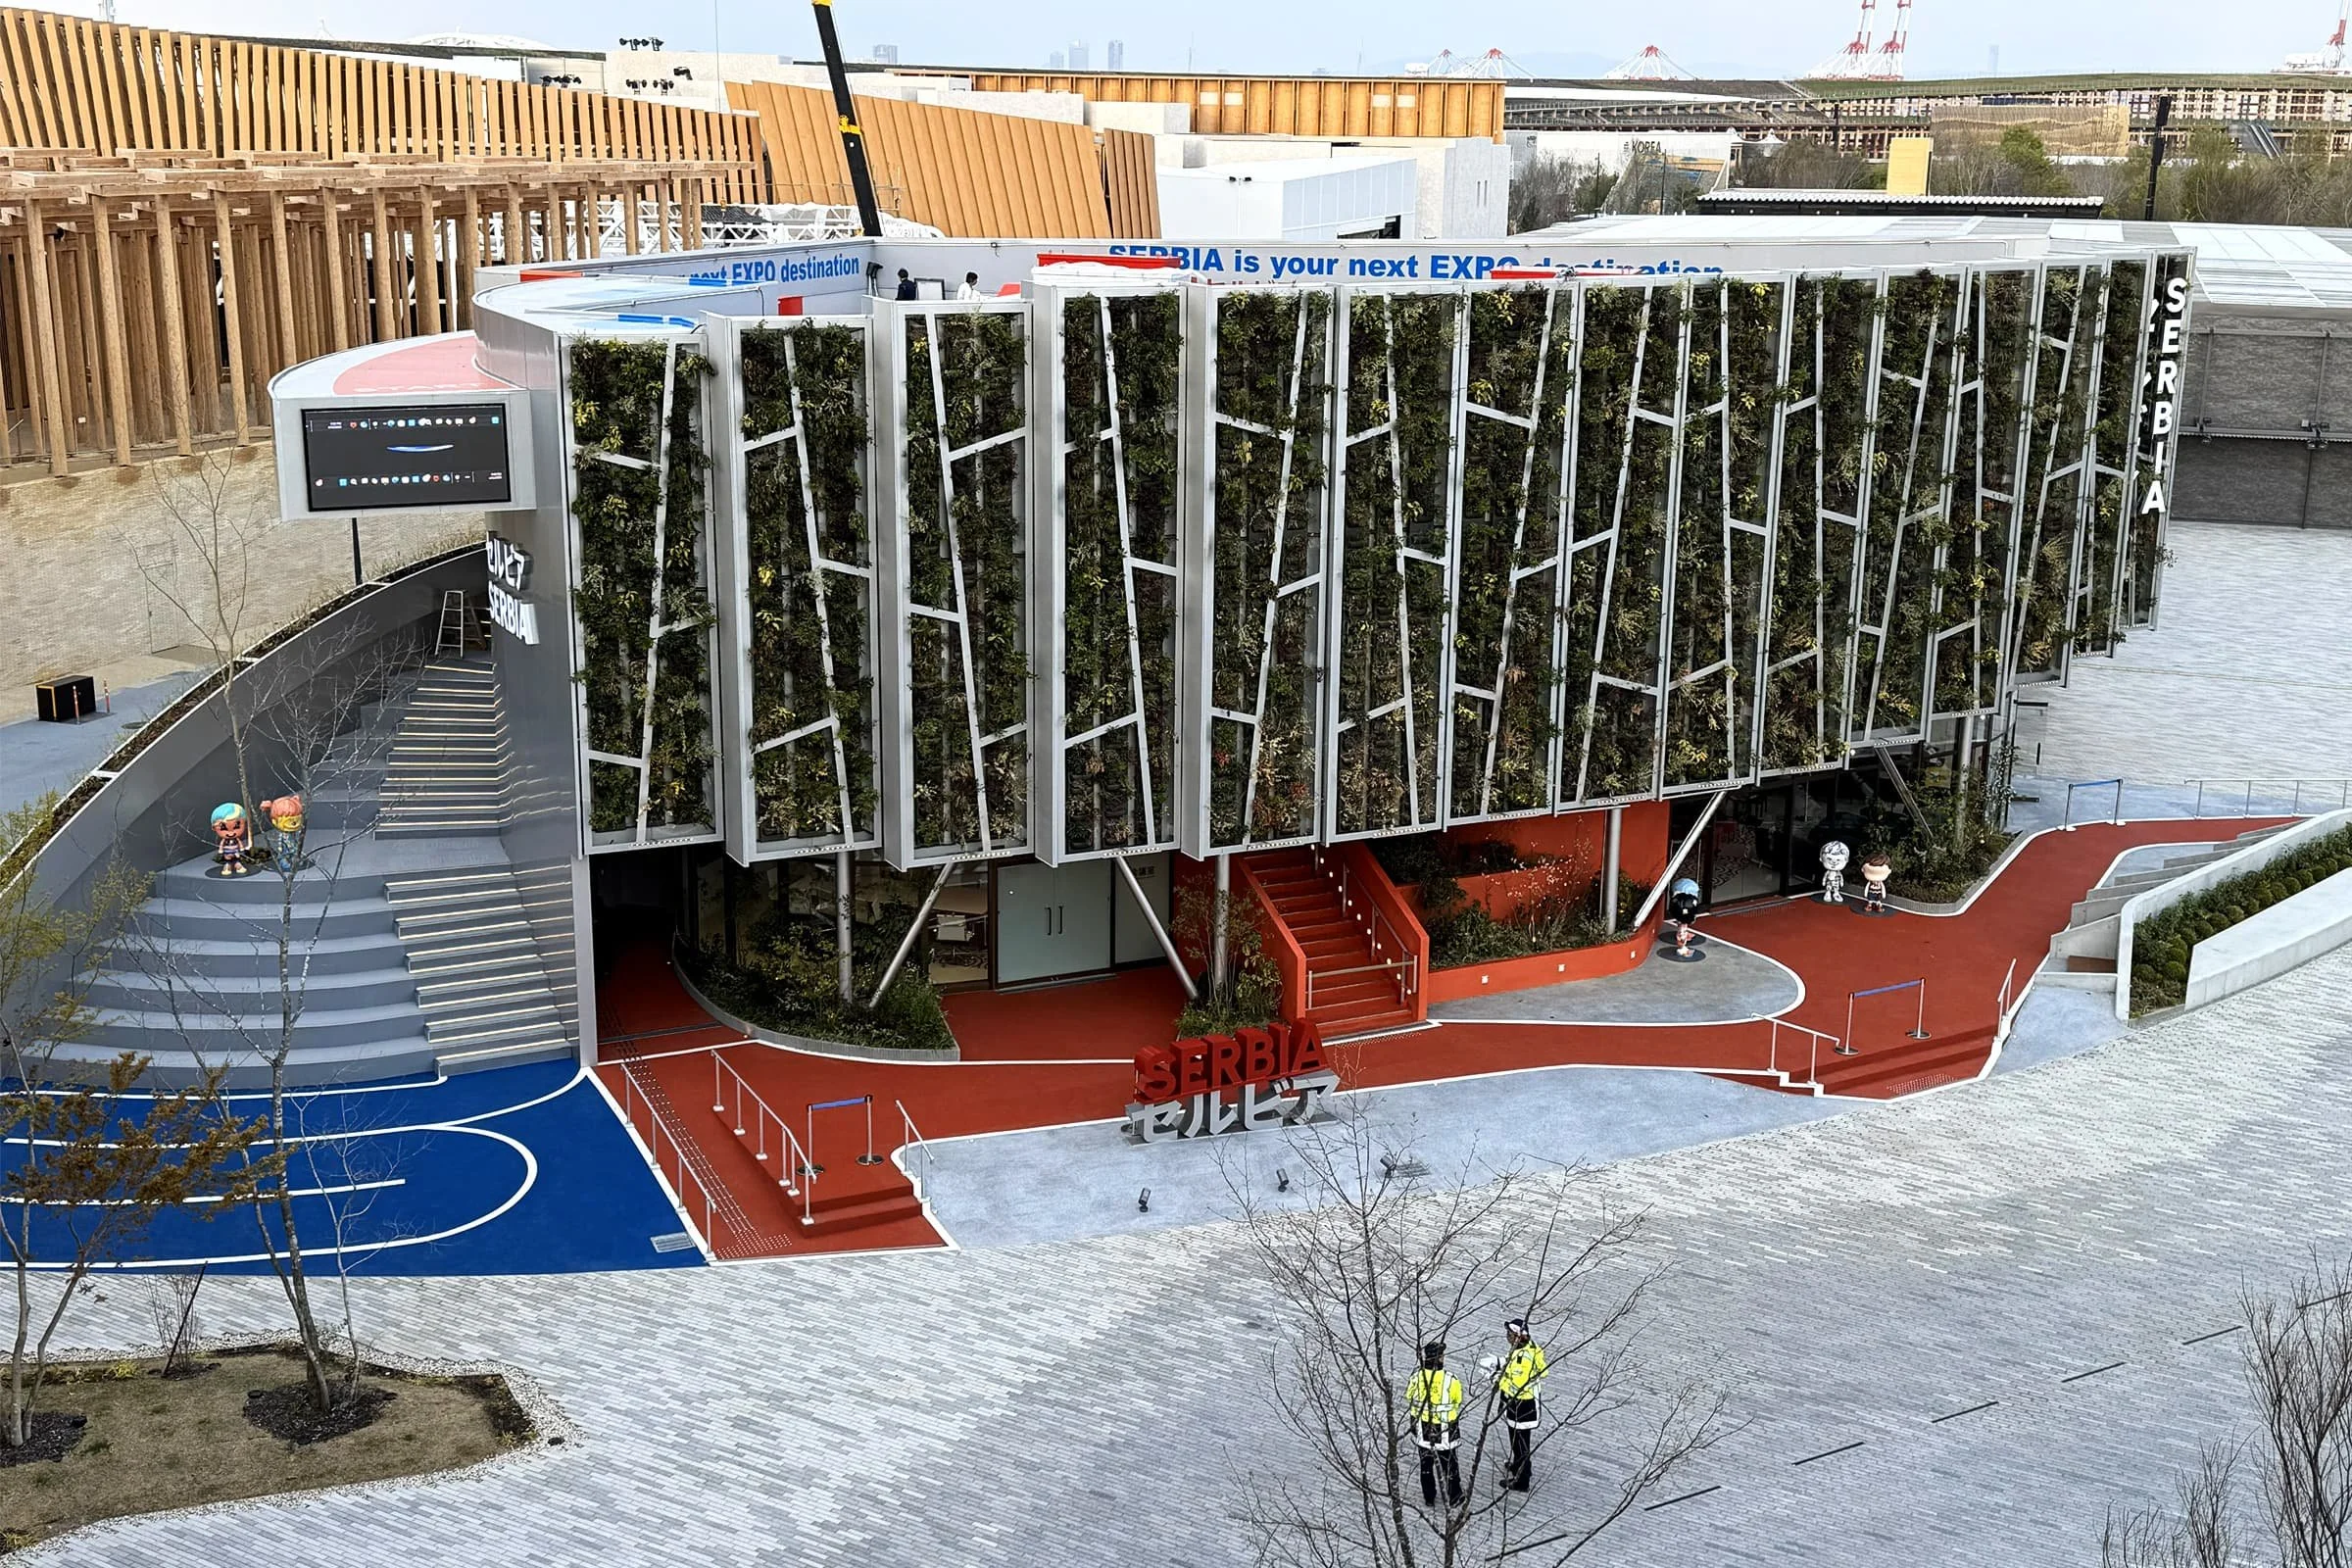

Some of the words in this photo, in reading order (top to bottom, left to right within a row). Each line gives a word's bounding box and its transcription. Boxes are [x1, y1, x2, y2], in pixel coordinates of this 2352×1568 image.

[781, 253, 859, 282] destination
[1235, 249, 1260, 272] is
[1271, 257, 1339, 278] your
[1349, 255, 1418, 278] next
[2141, 277, 2187, 514] SERBIA
[489, 580, 537, 645] SERBIA
[1135, 1021, 1326, 1100] SERBIA
[1131, 1077, 1341, 1143] セルビア
